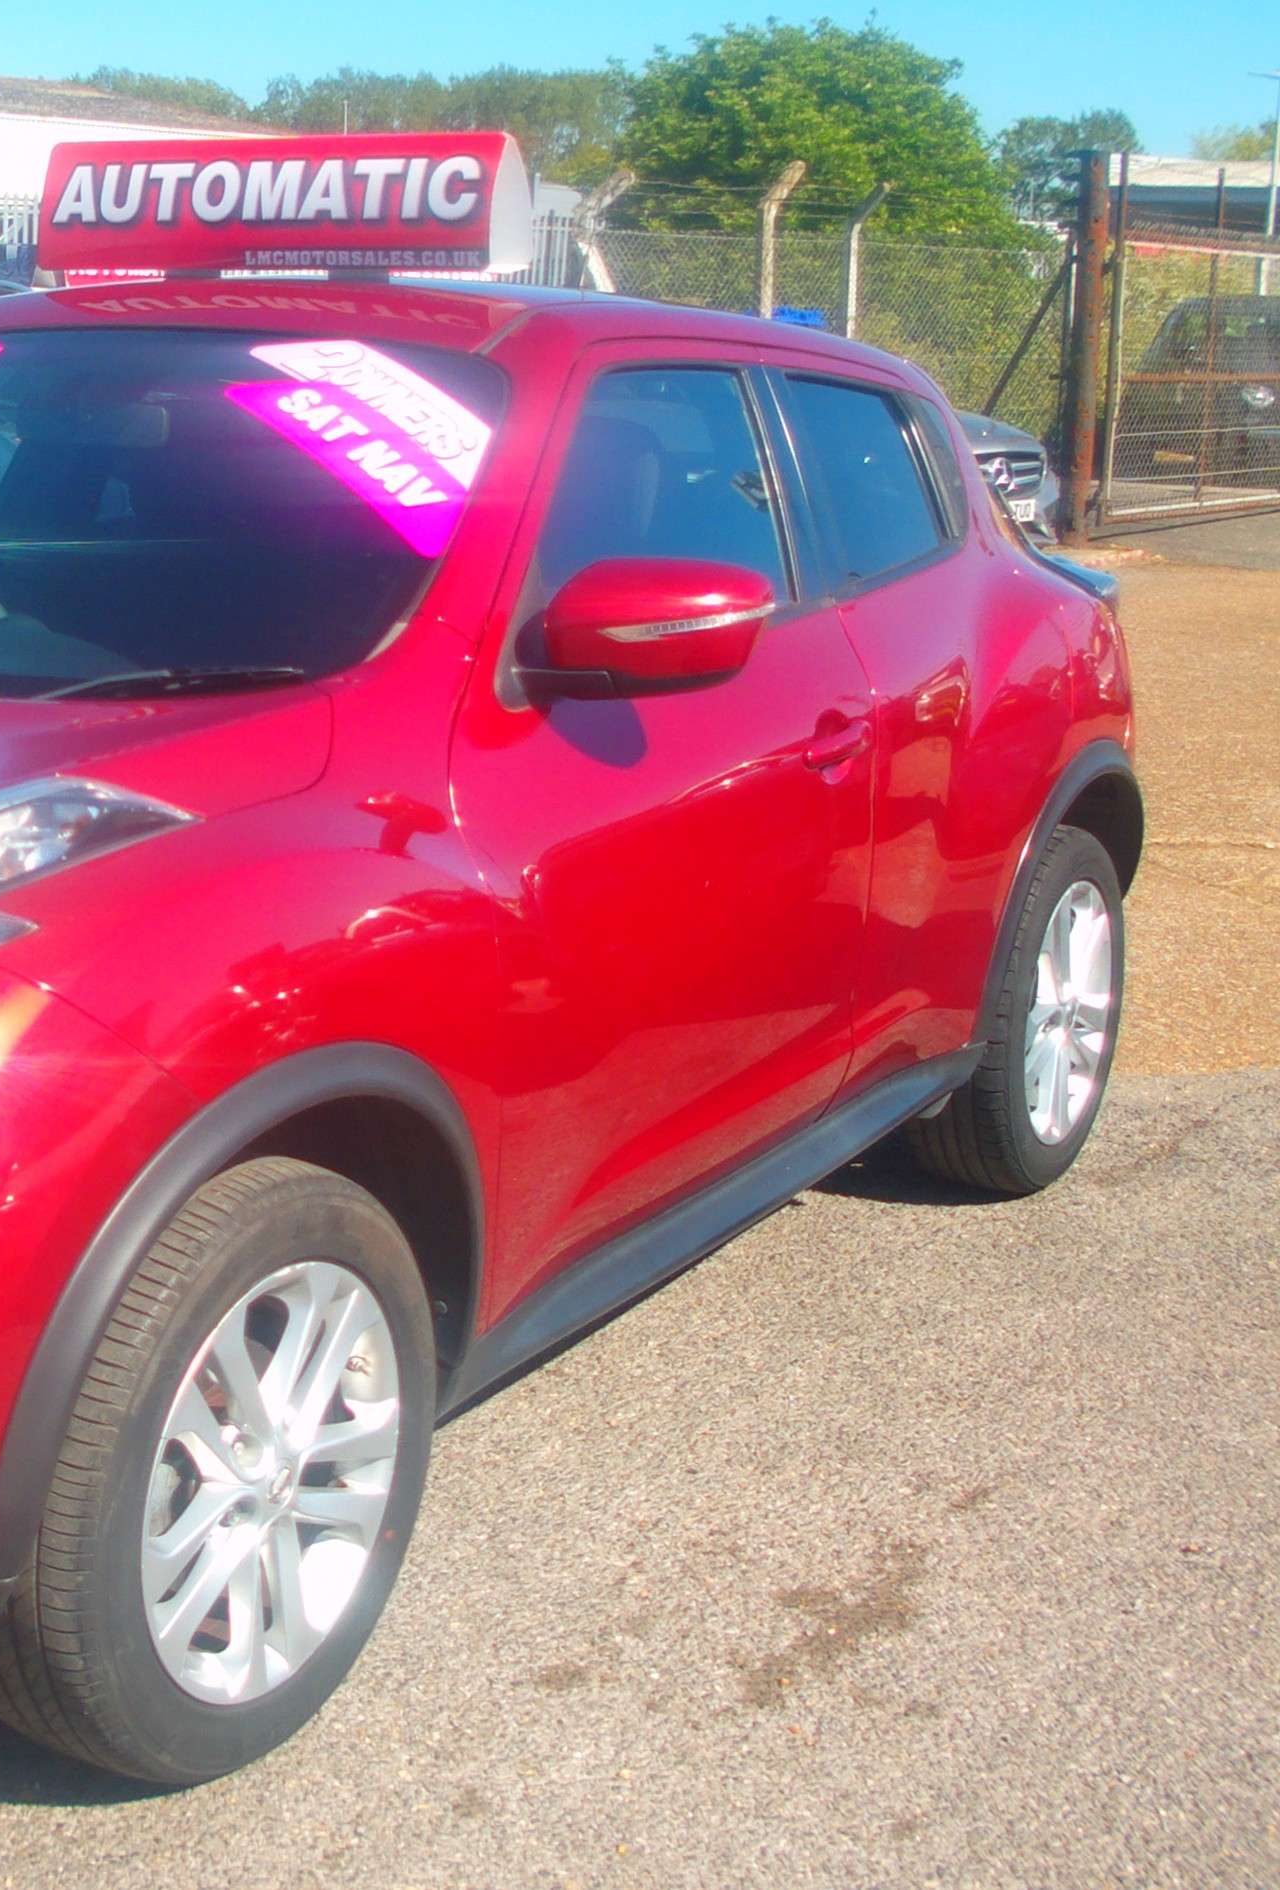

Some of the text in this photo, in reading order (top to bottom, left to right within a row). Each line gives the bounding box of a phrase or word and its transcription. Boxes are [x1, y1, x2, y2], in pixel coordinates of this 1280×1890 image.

[53, 156, 480, 223] AUTOMATIC
[245, 250, 481, 267] LMCMOTORSALES.CO.UK
[277, 388, 449, 508] SAT NAV
[327, 363, 478, 460] OWNERS
